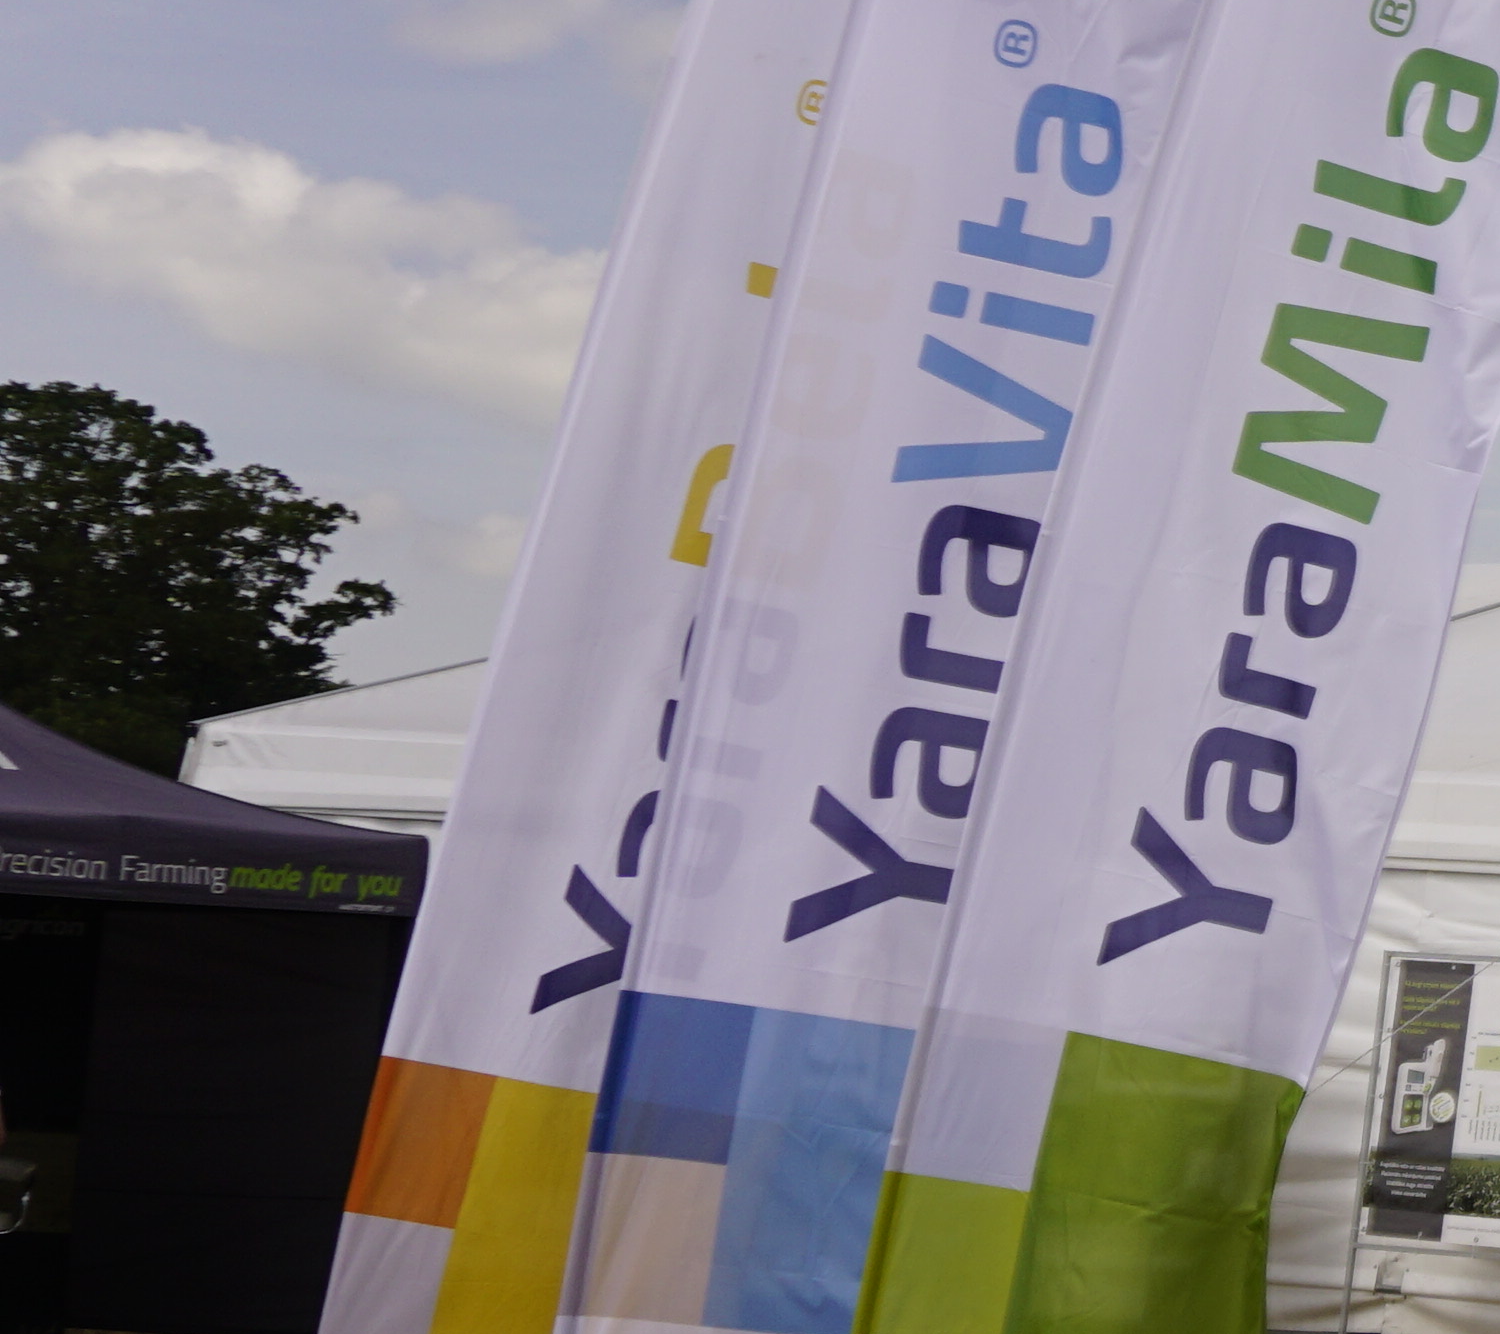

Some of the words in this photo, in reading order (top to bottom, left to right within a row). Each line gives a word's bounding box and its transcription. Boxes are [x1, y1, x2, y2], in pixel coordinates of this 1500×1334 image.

[0, 849, 106, 880] recision
[119, 854, 230, 895] Farming
[229, 863, 304, 891] made
[307, 864, 348, 899] for
[357, 873, 404, 902] you
